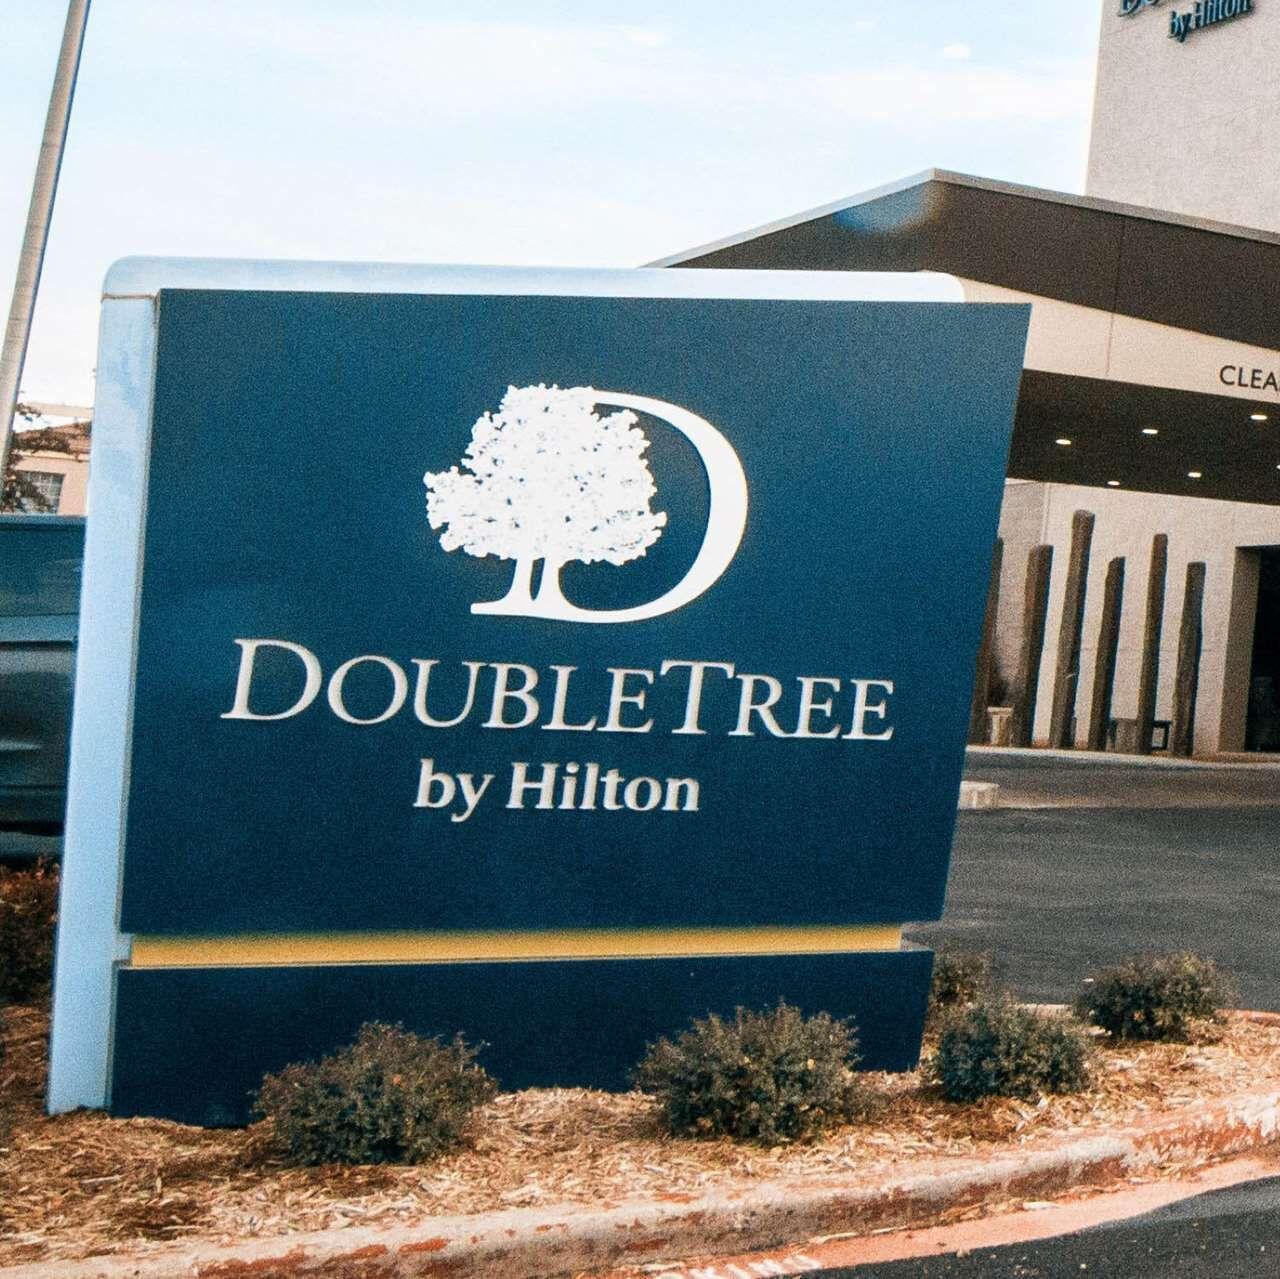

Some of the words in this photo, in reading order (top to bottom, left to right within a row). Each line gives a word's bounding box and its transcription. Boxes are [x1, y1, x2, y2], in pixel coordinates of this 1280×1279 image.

[1167, 11, 1193, 42] by
[220, 637, 895, 741] DOUBLETREE
[413, 757, 495, 823] by
[505, 760, 700, 812] Hilton
